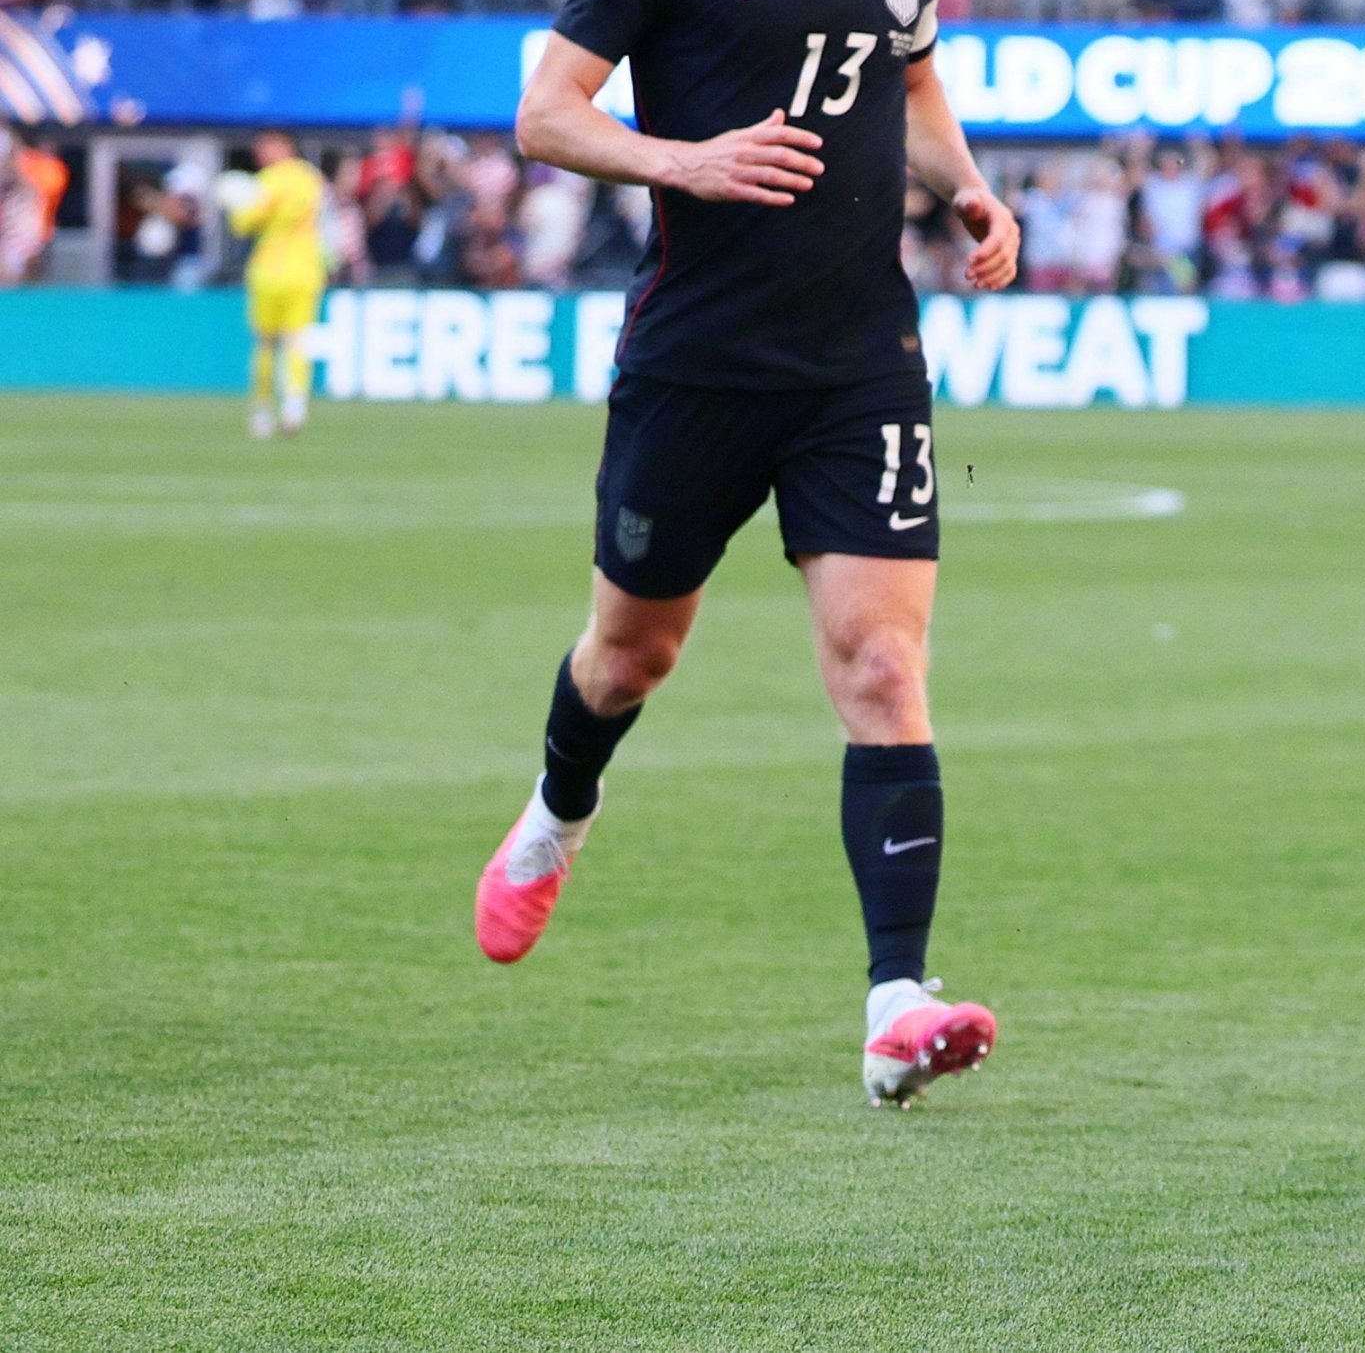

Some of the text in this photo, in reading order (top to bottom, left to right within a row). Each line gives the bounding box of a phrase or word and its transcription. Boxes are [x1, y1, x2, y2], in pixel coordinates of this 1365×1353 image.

[789, 31, 878, 117] 13
[1073, 35, 1275, 125] CUP
[302, 287, 555, 404] HERE
[918, 293, 1210, 409] WEAT
[876, 423, 935, 505] 13
